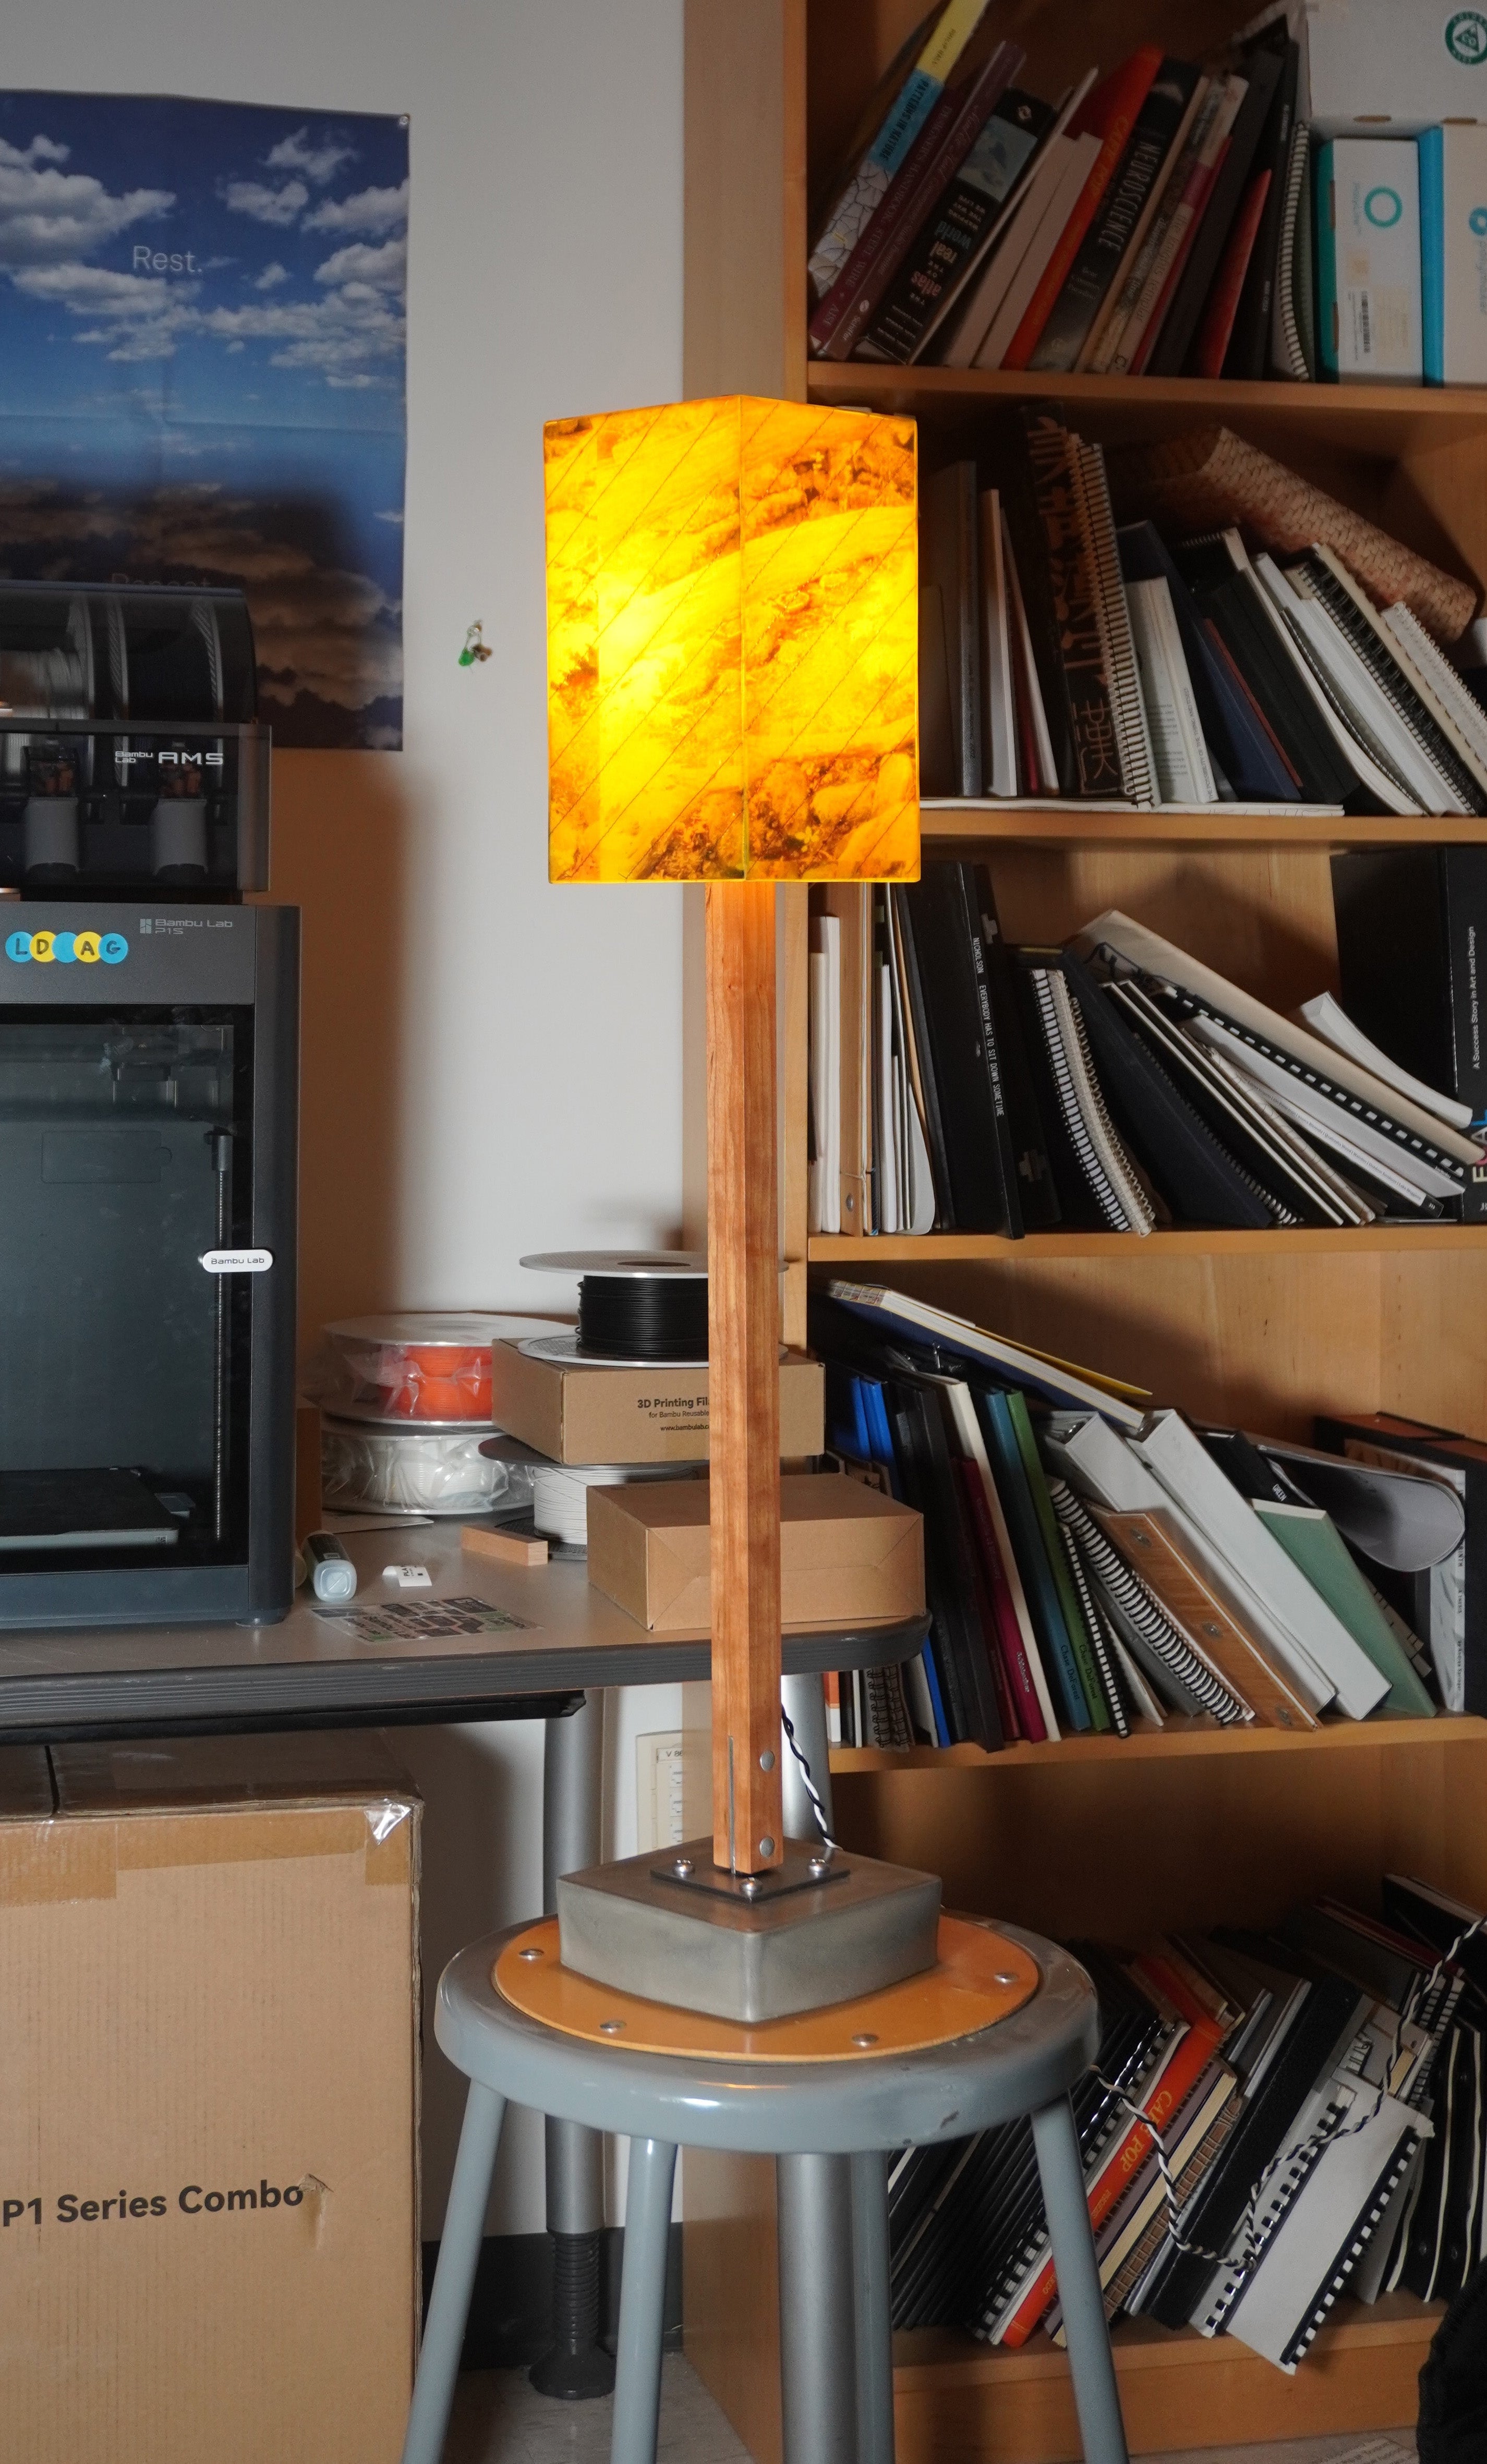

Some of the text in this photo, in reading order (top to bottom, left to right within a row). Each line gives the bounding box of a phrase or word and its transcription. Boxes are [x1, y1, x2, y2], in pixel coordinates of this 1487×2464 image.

[900, 78, 930, 121] PATTERNS
[895, 118, 909, 130] IN
[1096, 141, 1162, 251] NEUROSCIENCE
[933, 219, 974, 253] world
[1170, 212, 1189, 234] the
[133, 246, 203, 273] Rest.
[928, 239, 960, 268] real
[1150, 233, 1180, 278] knights
[844, 259, 867, 289] WIRE
[906, 269, 944, 301] atlas
[908, 291, 927, 306] THE
[839, 313, 863, 343] Schiffer
[1187, 705, 1195, 717] AND
[1194, 736, 1202, 747] THE
[1197, 748, 1204, 757] OF
[158, 752, 224, 765] AMS
[155, 919, 233, 928] Bambu Lab
[1467, 926, 1477, 956] Design
[1470, 990, 1477, 998] in
[972, 937, 1004, 1116] NICHOLSON EVERYBODY HAS TO SIT DOWN SOMETIME
[637, 1397, 710, 1409] 3D Printing Fil
[1271, 1483, 1287, 1502] GREEN
[1060, 1644, 1080, 1700] Chase DeForest
[1078, 1643, 1097, 1699] Chase DeForest
[1116, 2134, 1147, 2173] POP
[2, 2179, 304, 2227] P1 Series Combo
